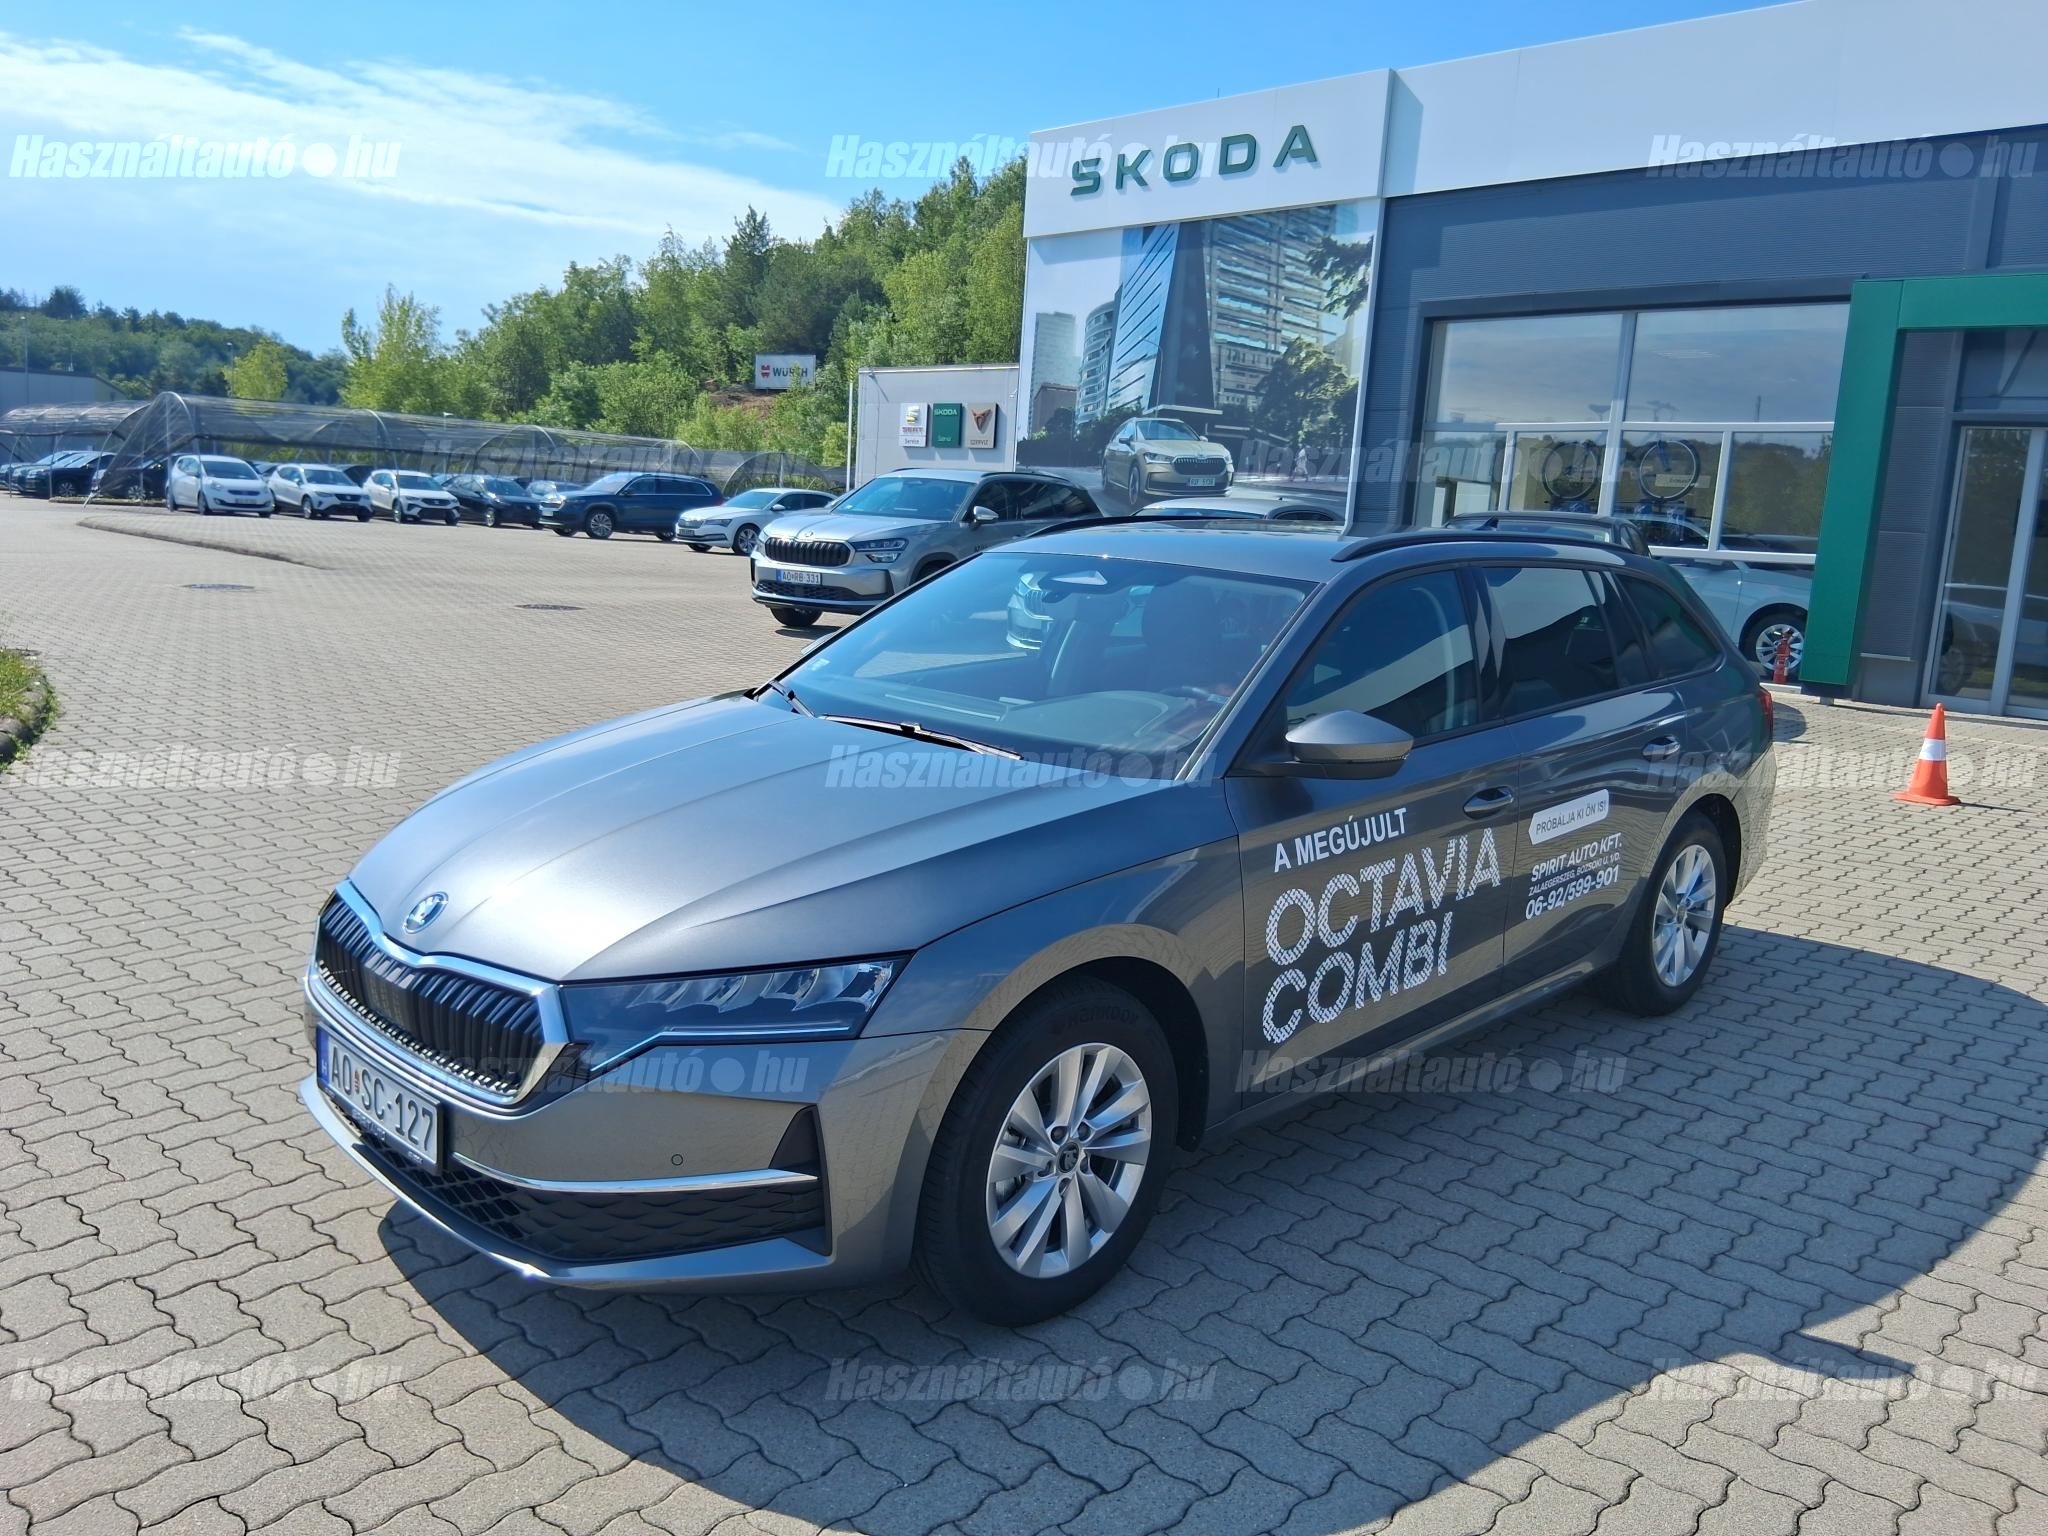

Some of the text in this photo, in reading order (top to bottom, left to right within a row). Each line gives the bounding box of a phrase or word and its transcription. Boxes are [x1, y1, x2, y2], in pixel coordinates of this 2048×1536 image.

[1274, 807, 1407, 873] A MEGÚJULT
[1576, 808, 1584, 819] KI
[1585, 802, 1595, 817] ÖN
[1531, 832, 1622, 882] SPIRIT AUTO KFT.
[1265, 827, 1501, 967] OCTAVIA
[1525, 864, 1620, 920] 06-92/599-901
[1262, 911, 1453, 1044] COMBI
